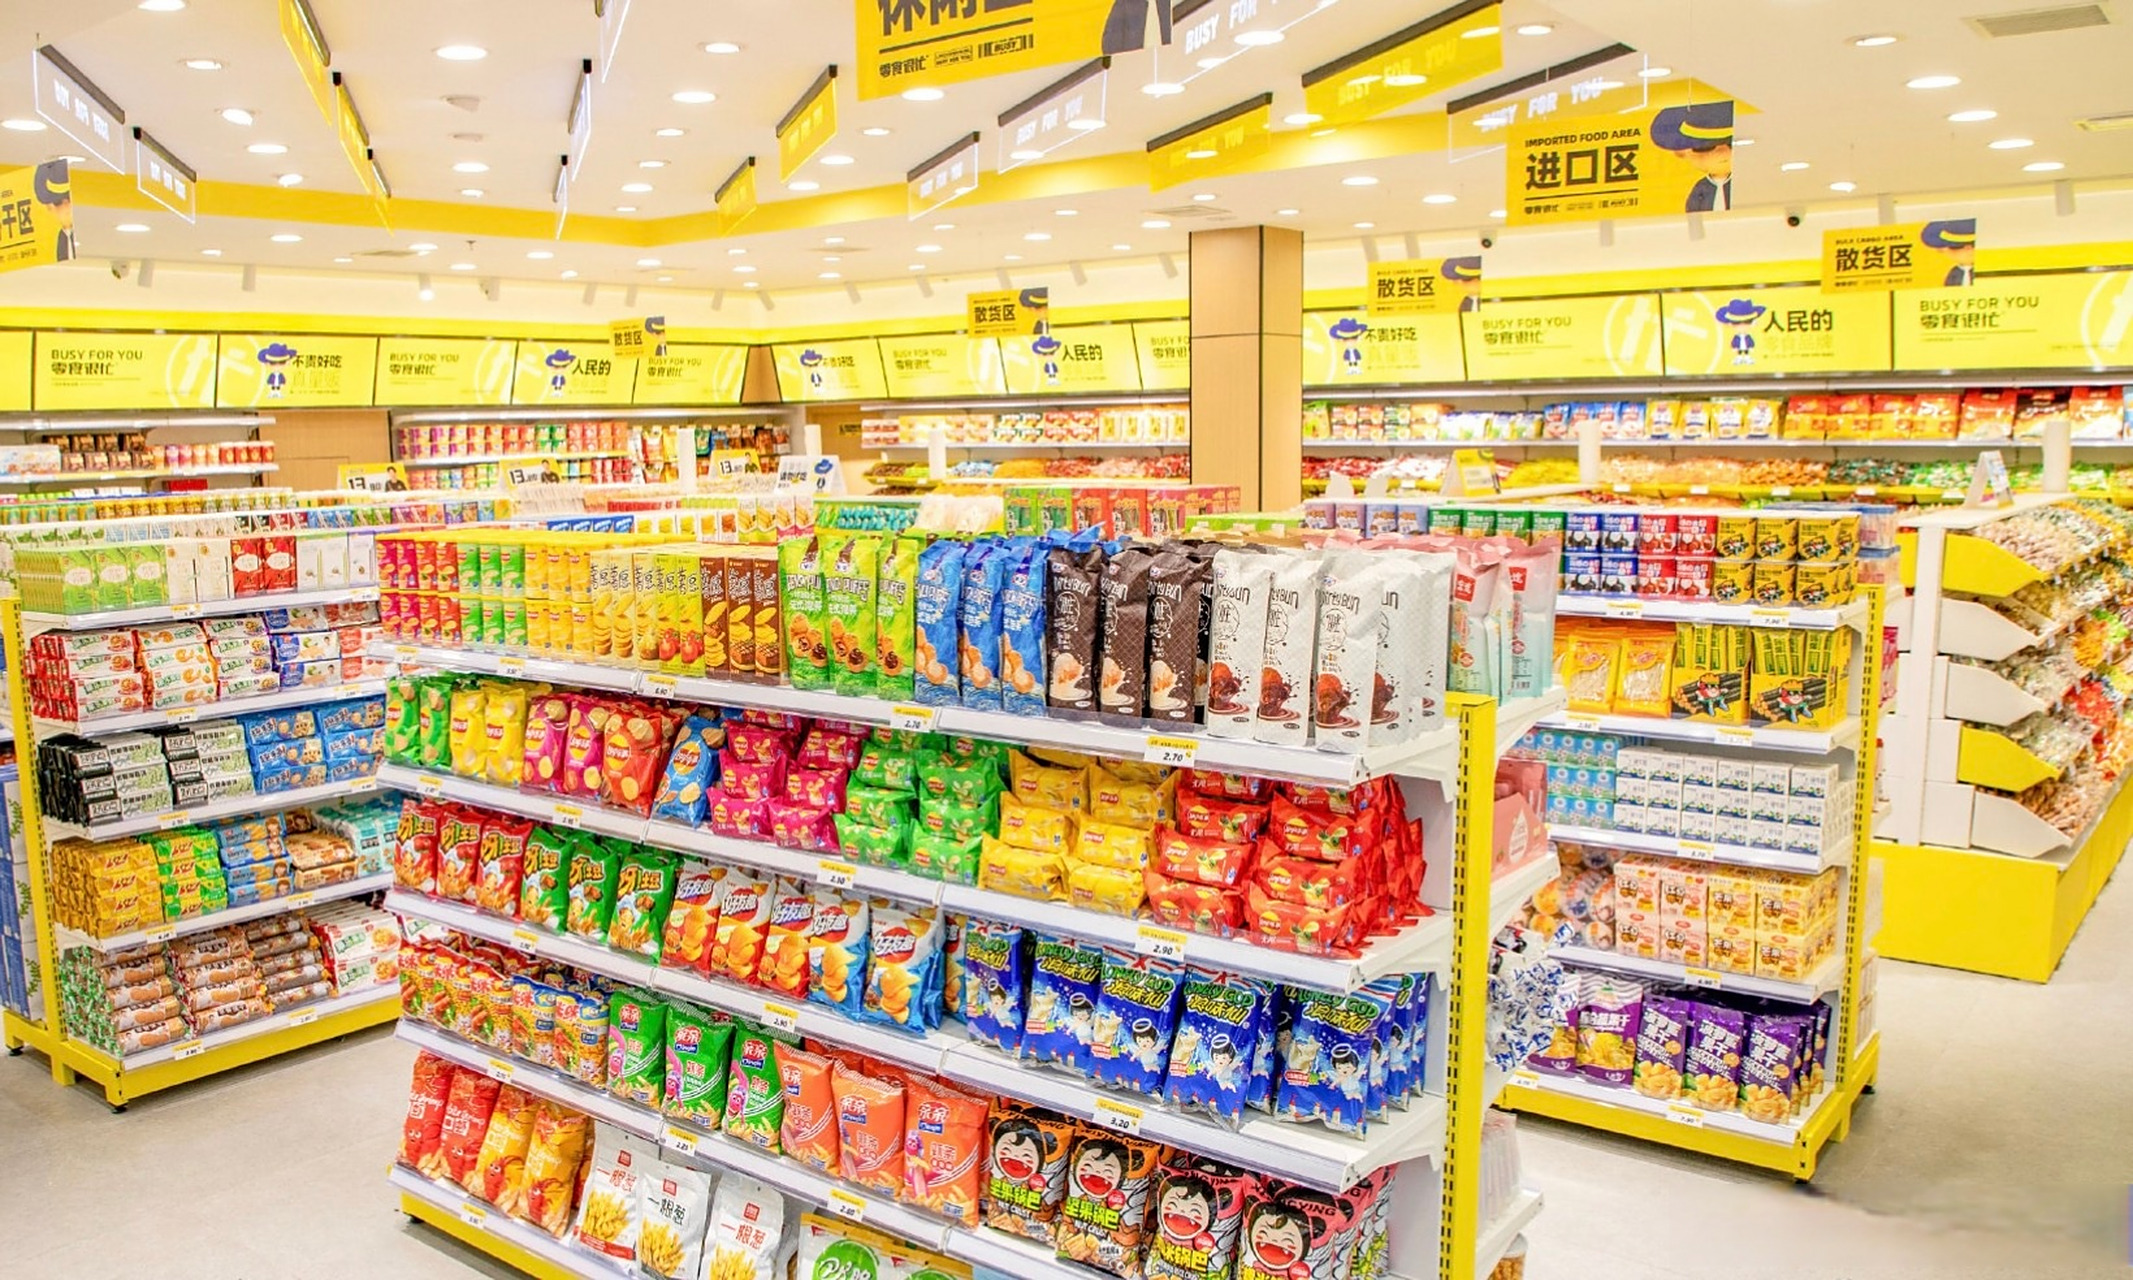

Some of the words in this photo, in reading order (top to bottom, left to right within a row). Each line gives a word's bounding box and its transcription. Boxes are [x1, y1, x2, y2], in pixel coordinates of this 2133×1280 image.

[878, 0, 1034, 36] 休闲
[1185, 13, 1219, 54] BUSY
[1528, 92, 1558, 118] FOR
[1525, 134, 1578, 148] IMPORTED
[1580, 131, 1608, 143] FOOD
[1612, 128, 1641, 139] AREA
[1525, 144, 1640, 190] 进口区
[0, 198, 35, 240] 干区
[1836, 243, 1913, 273] 散货区
[1376, 276, 1436, 298] 散货区
[973, 303, 1016, 323] 散货区
[1920, 299, 1963, 312] BUSY
[1966, 297, 1999, 310] FOR
[2004, 296, 2040, 309] YOU
[1482, 319, 1513, 330] BUSY
[1516, 318, 1542, 328] FOR
[1546, 316, 1572, 327] YOU
[1764, 309, 1834, 333] 人民的
[51, 349, 85, 360] BUSY
[88, 349, 114, 360] FOR
[117, 350, 143, 360] YOU
[1061, 343, 1103, 362] 人民的
[572, 359, 611, 376] 人民的
[1163, 752, 1184, 762] 2.70
[721, 890, 759, 916] 好友趣
[771, 900, 813, 924] 好友趣
[812, 911, 849, 934] 好友趣
[872, 930, 917, 956] 好友趣
[1153, 944, 1173, 955] 2.90
[1101, 962, 1143, 985] LONELY
[1143, 972, 1175, 993] GOD
[1104, 980, 1170, 1010] 浪味仙
[1184, 980, 1224, 999] LONELY
[1224, 988, 1255, 1007] GOD
[1187, 995, 1249, 1024] 浪味仙
[1305, 1002, 1371, 1033] 浪味仙
[1346, 997, 1380, 1018] GOD
[1110, 1117, 1130, 1129] 3.20
[1065, 1195, 1120, 1231] 坚果锅巴
